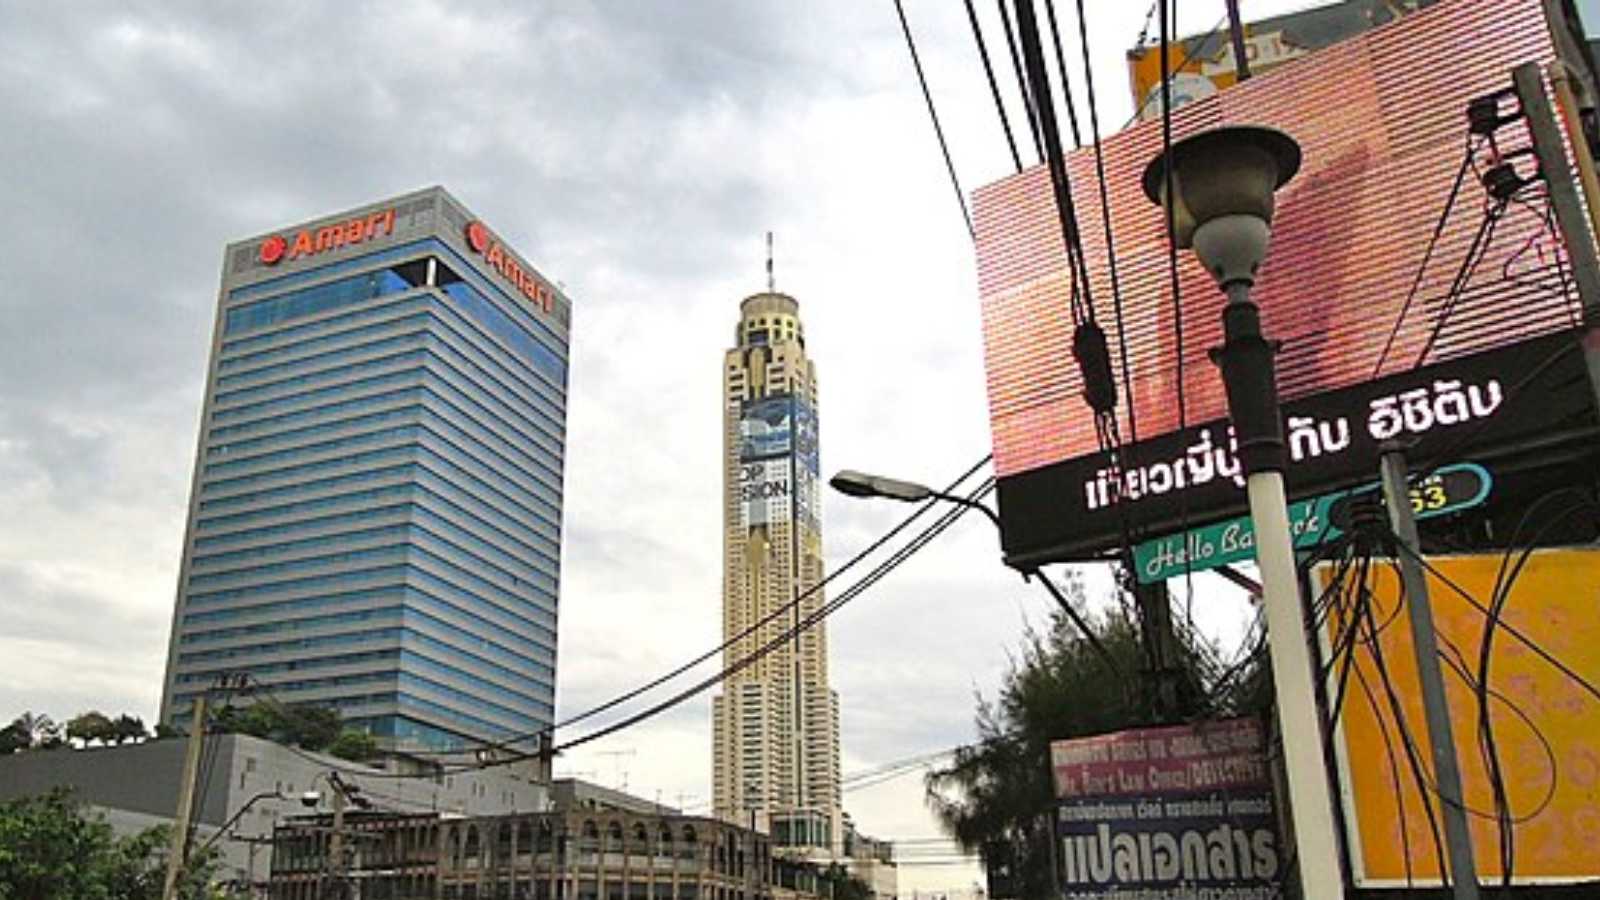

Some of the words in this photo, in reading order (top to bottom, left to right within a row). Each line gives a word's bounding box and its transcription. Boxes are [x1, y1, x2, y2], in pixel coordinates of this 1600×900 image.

[288, 208, 396, 259] Amari
[485, 246, 553, 314] Amari
[1146, 533, 1214, 576] Hello
[1064, 823, 1279, 882] แปลเอกสาร
